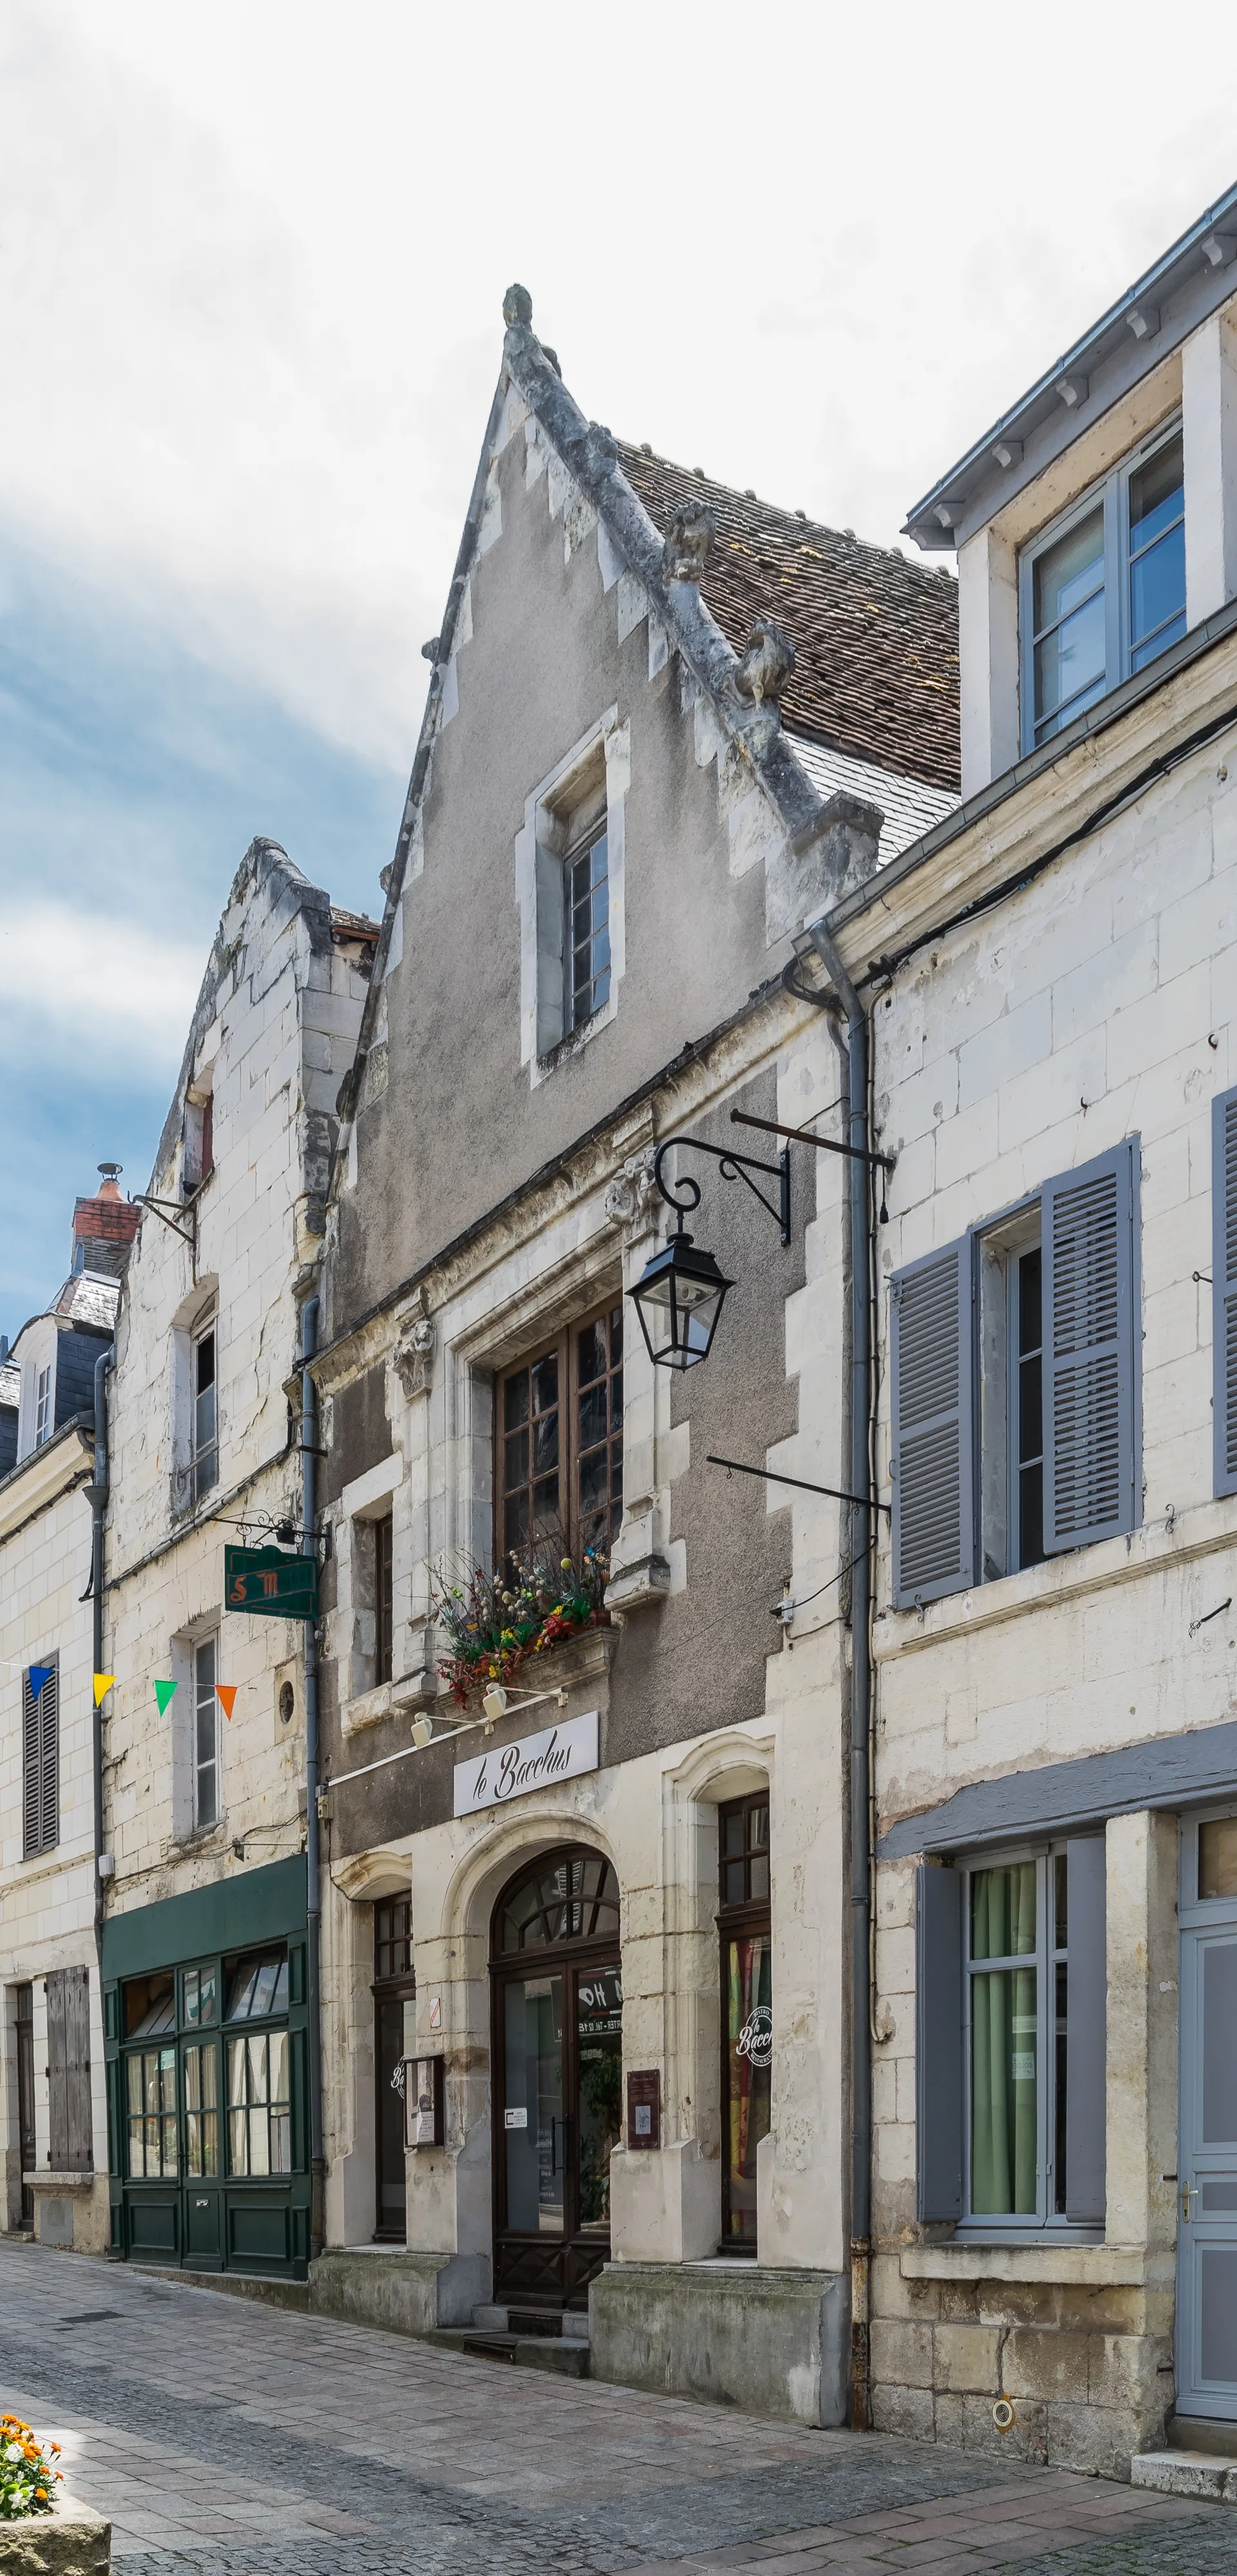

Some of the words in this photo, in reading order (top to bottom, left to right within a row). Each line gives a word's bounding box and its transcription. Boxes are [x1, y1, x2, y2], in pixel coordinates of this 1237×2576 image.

[230, 1576, 247, 1602] S
[473, 1757, 487, 1801] le
[494, 1729, 572, 1799] Bacchus
[753, 2008, 770, 2018] BISTRO
